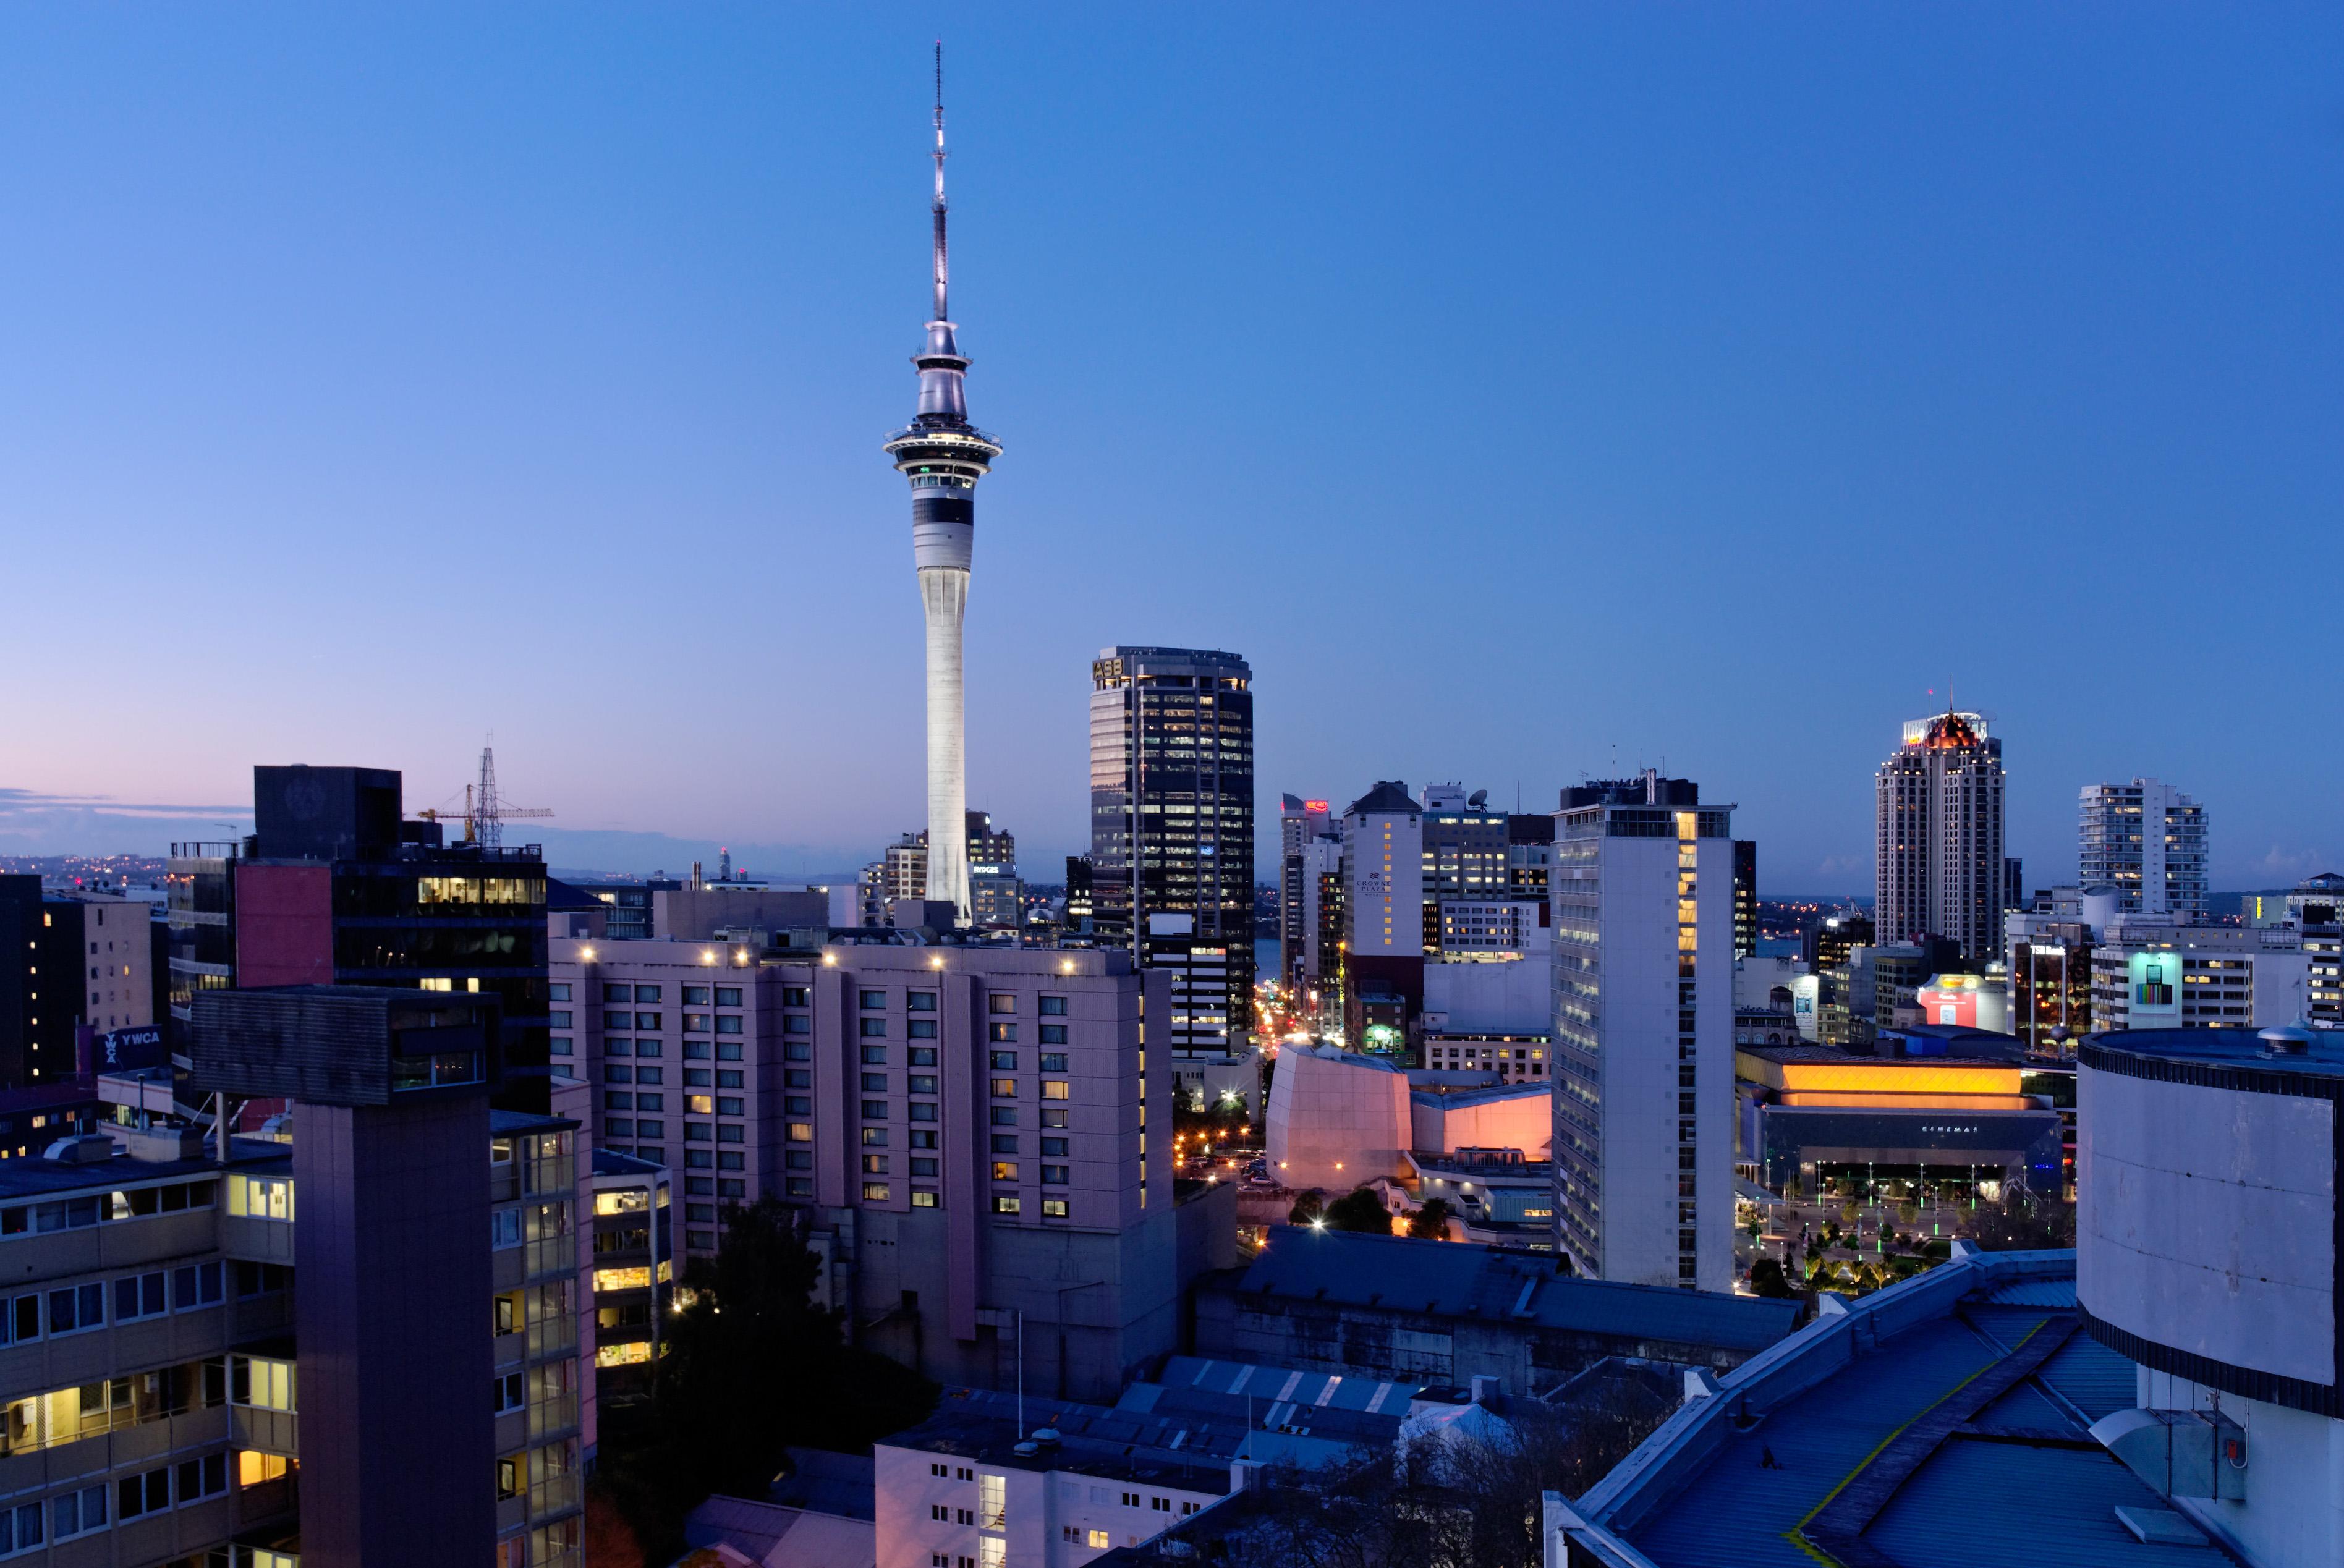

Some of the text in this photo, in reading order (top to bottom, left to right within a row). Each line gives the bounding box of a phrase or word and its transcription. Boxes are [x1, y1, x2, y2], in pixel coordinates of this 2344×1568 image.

[1093, 659, 1122, 679] ASB
[2030, 946, 2066, 956] TSB Bank
[122, 1032, 160, 1046] YWCA
[105, 1033, 117, 1064] YWCA
